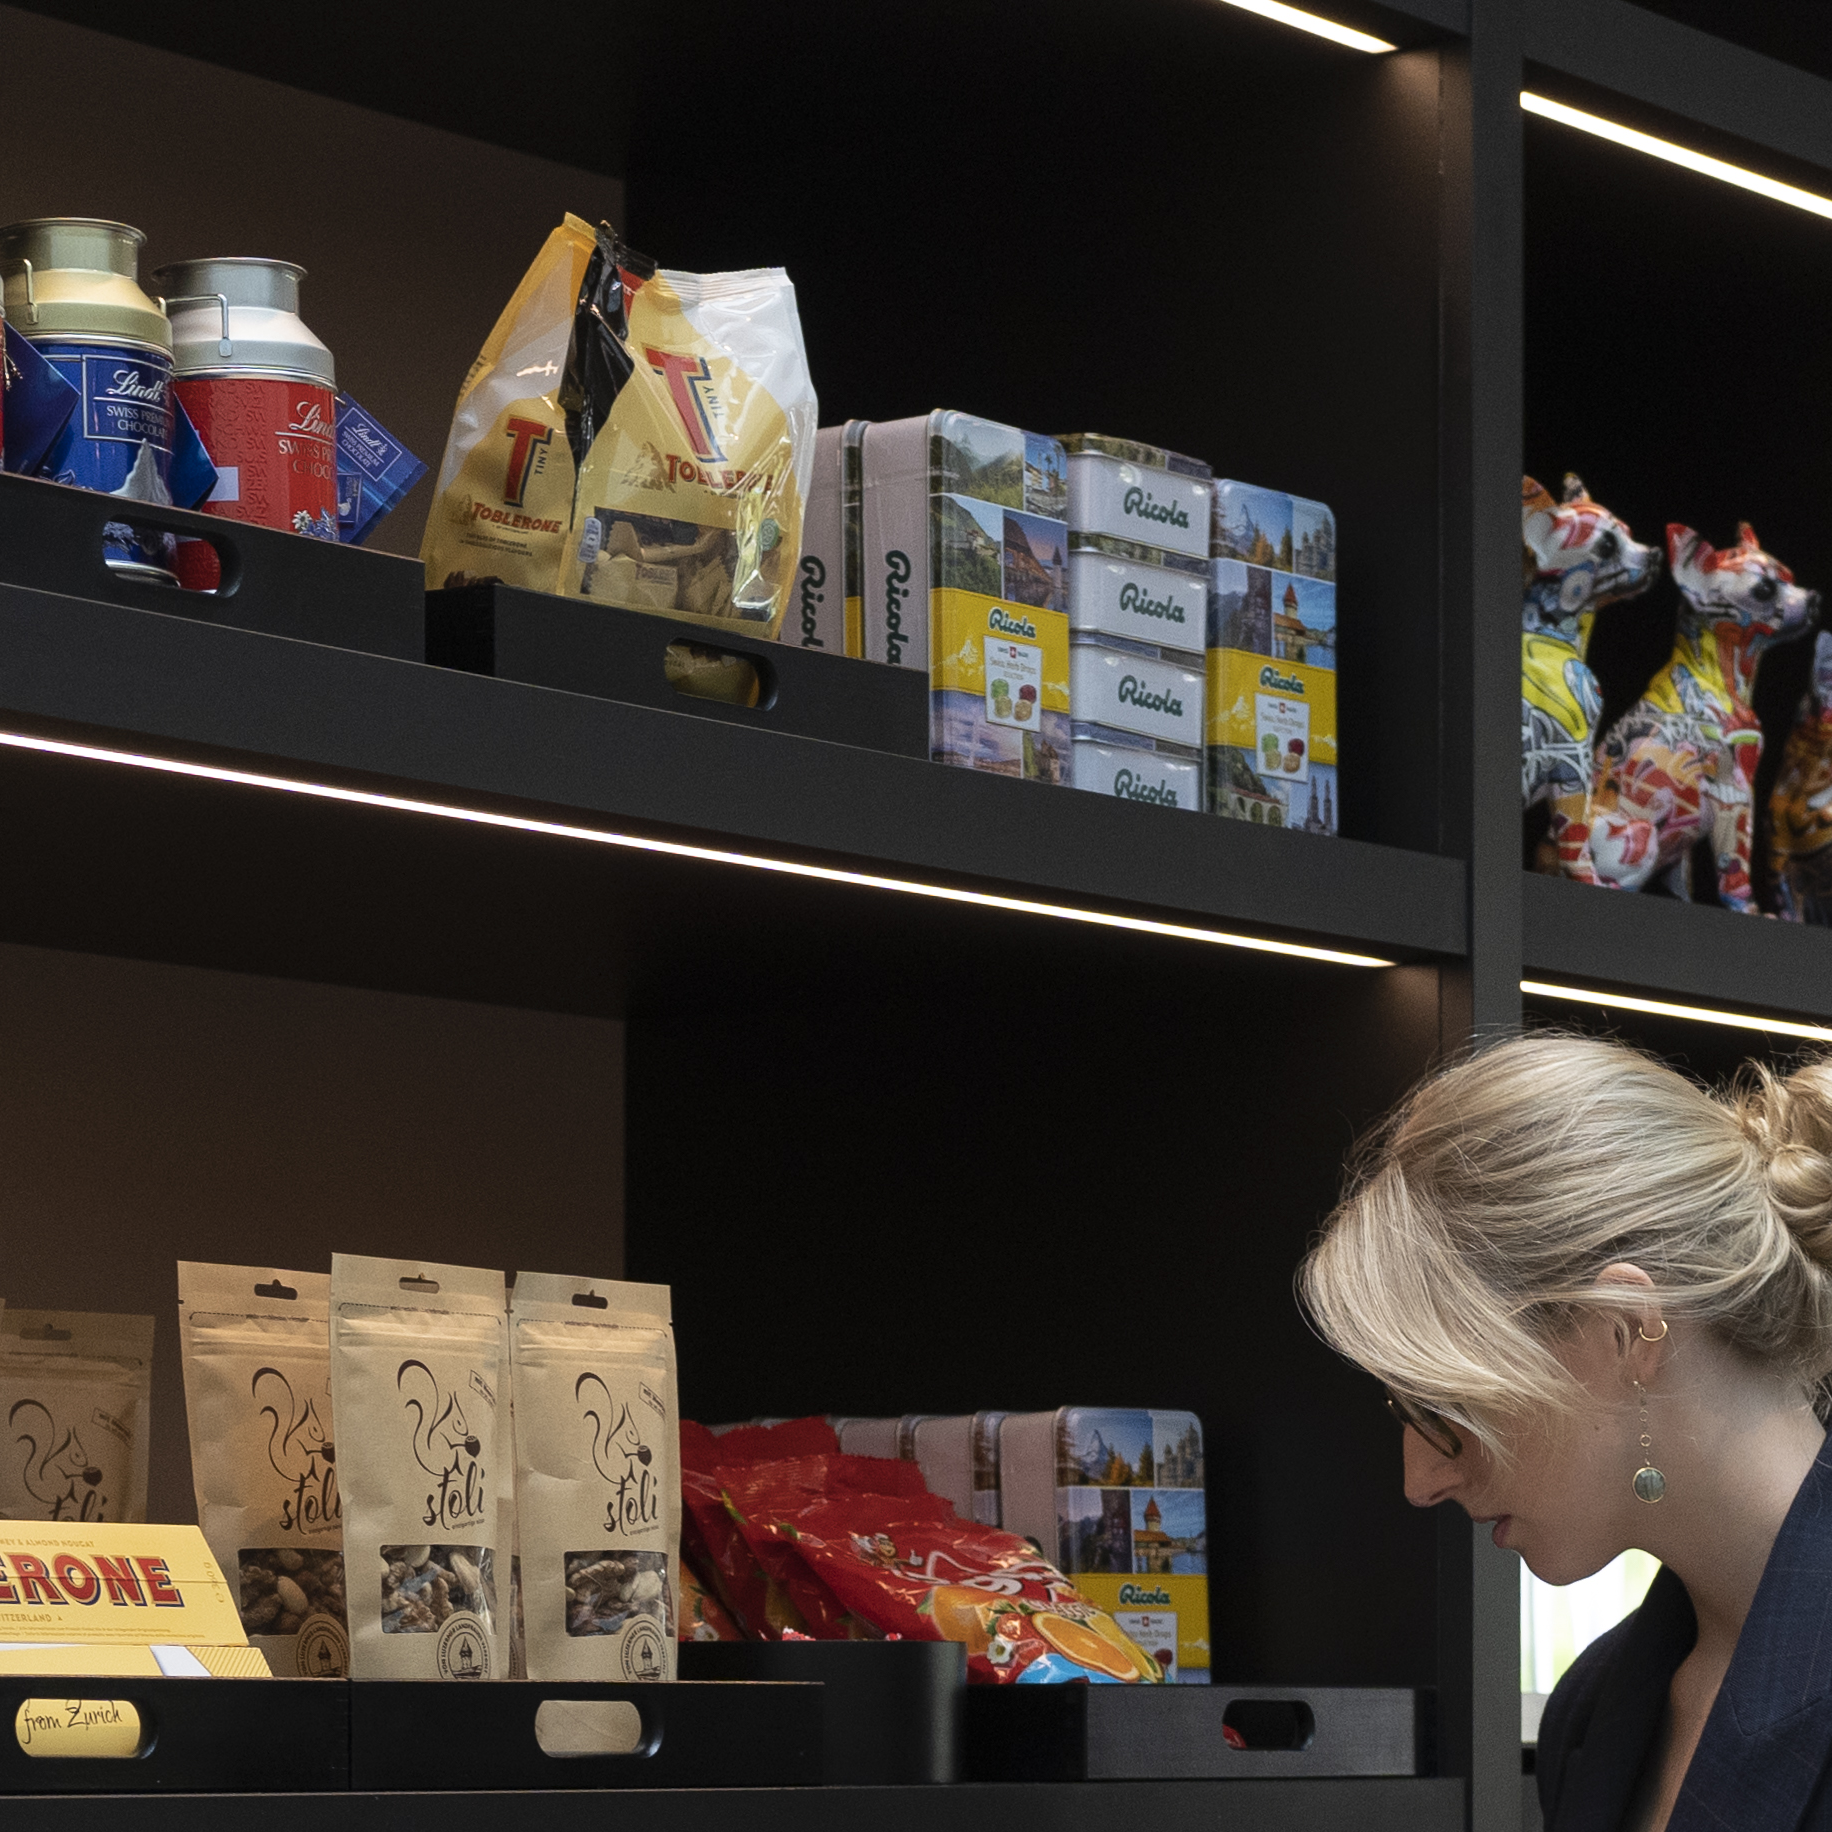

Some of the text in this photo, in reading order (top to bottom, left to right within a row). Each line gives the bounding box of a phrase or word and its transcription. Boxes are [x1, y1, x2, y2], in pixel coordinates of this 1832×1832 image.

[105, 370, 165, 403] Lindt
[702, 386, 725, 419] TINY
[107, 405, 139, 419] SWISS
[534, 447, 549, 475] TINY
[471, 502, 563, 534] TOBLERONE
[1124, 486, 1189, 529] Ricola
[800, 555, 826, 648] Ricol
[885, 549, 911, 664] Ricola
[1120, 583, 1185, 623] Ricola
[988, 606, 1037, 639] Ricola
[1118, 675, 1183, 717] Ricola
[1260, 664, 1304, 694] Ricola
[1114, 768, 1177, 807] Ricola
[422, 1461, 485, 1530] stoli
[603, 1469, 658, 1536] stoli
[1119, 1583, 1171, 1606] Ricola
[23, 1700, 61, 1744] from
